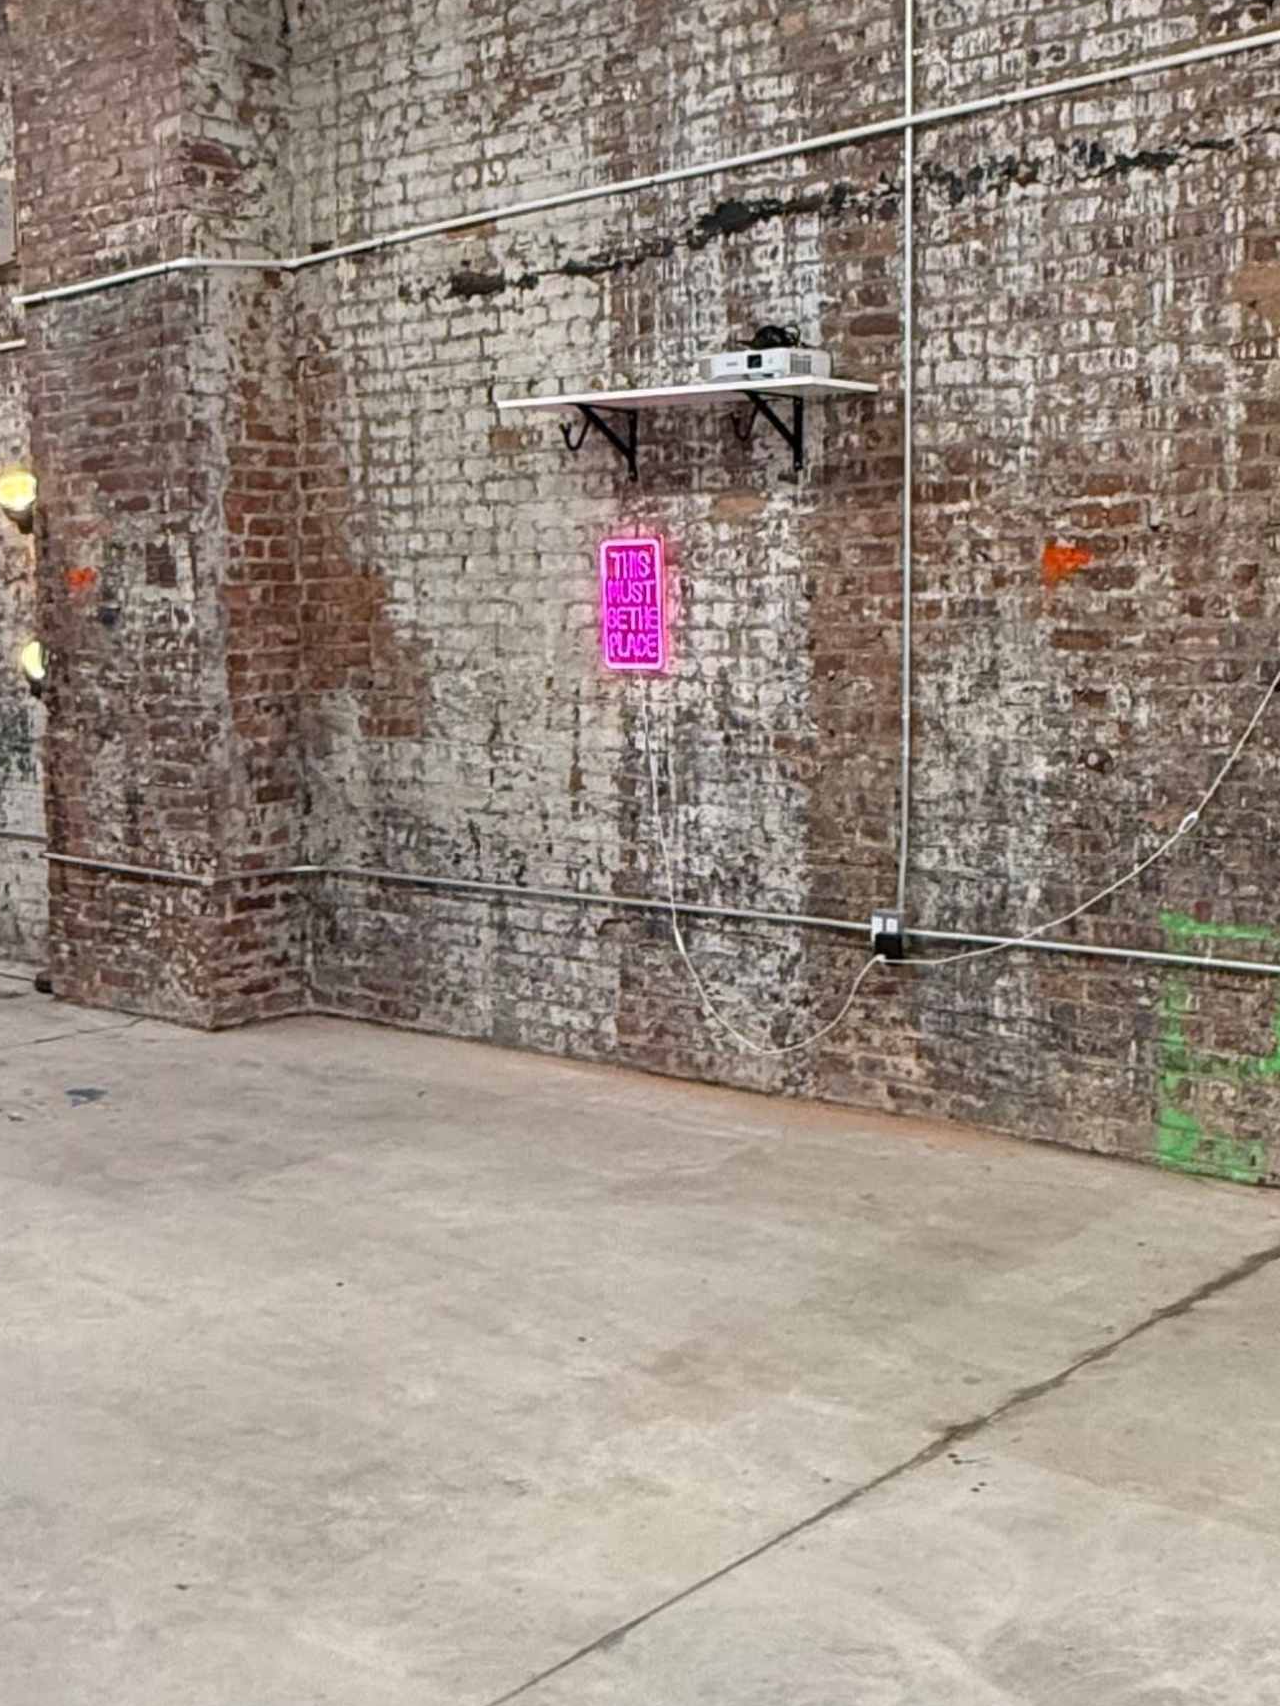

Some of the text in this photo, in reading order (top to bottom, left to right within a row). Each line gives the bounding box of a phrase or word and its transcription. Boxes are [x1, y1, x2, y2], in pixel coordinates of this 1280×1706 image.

[609, 550, 652, 579] THIS
[606, 579, 656, 604] MUST
[606, 605, 659, 630] BE THE
[608, 631, 659, 659] PLACE
